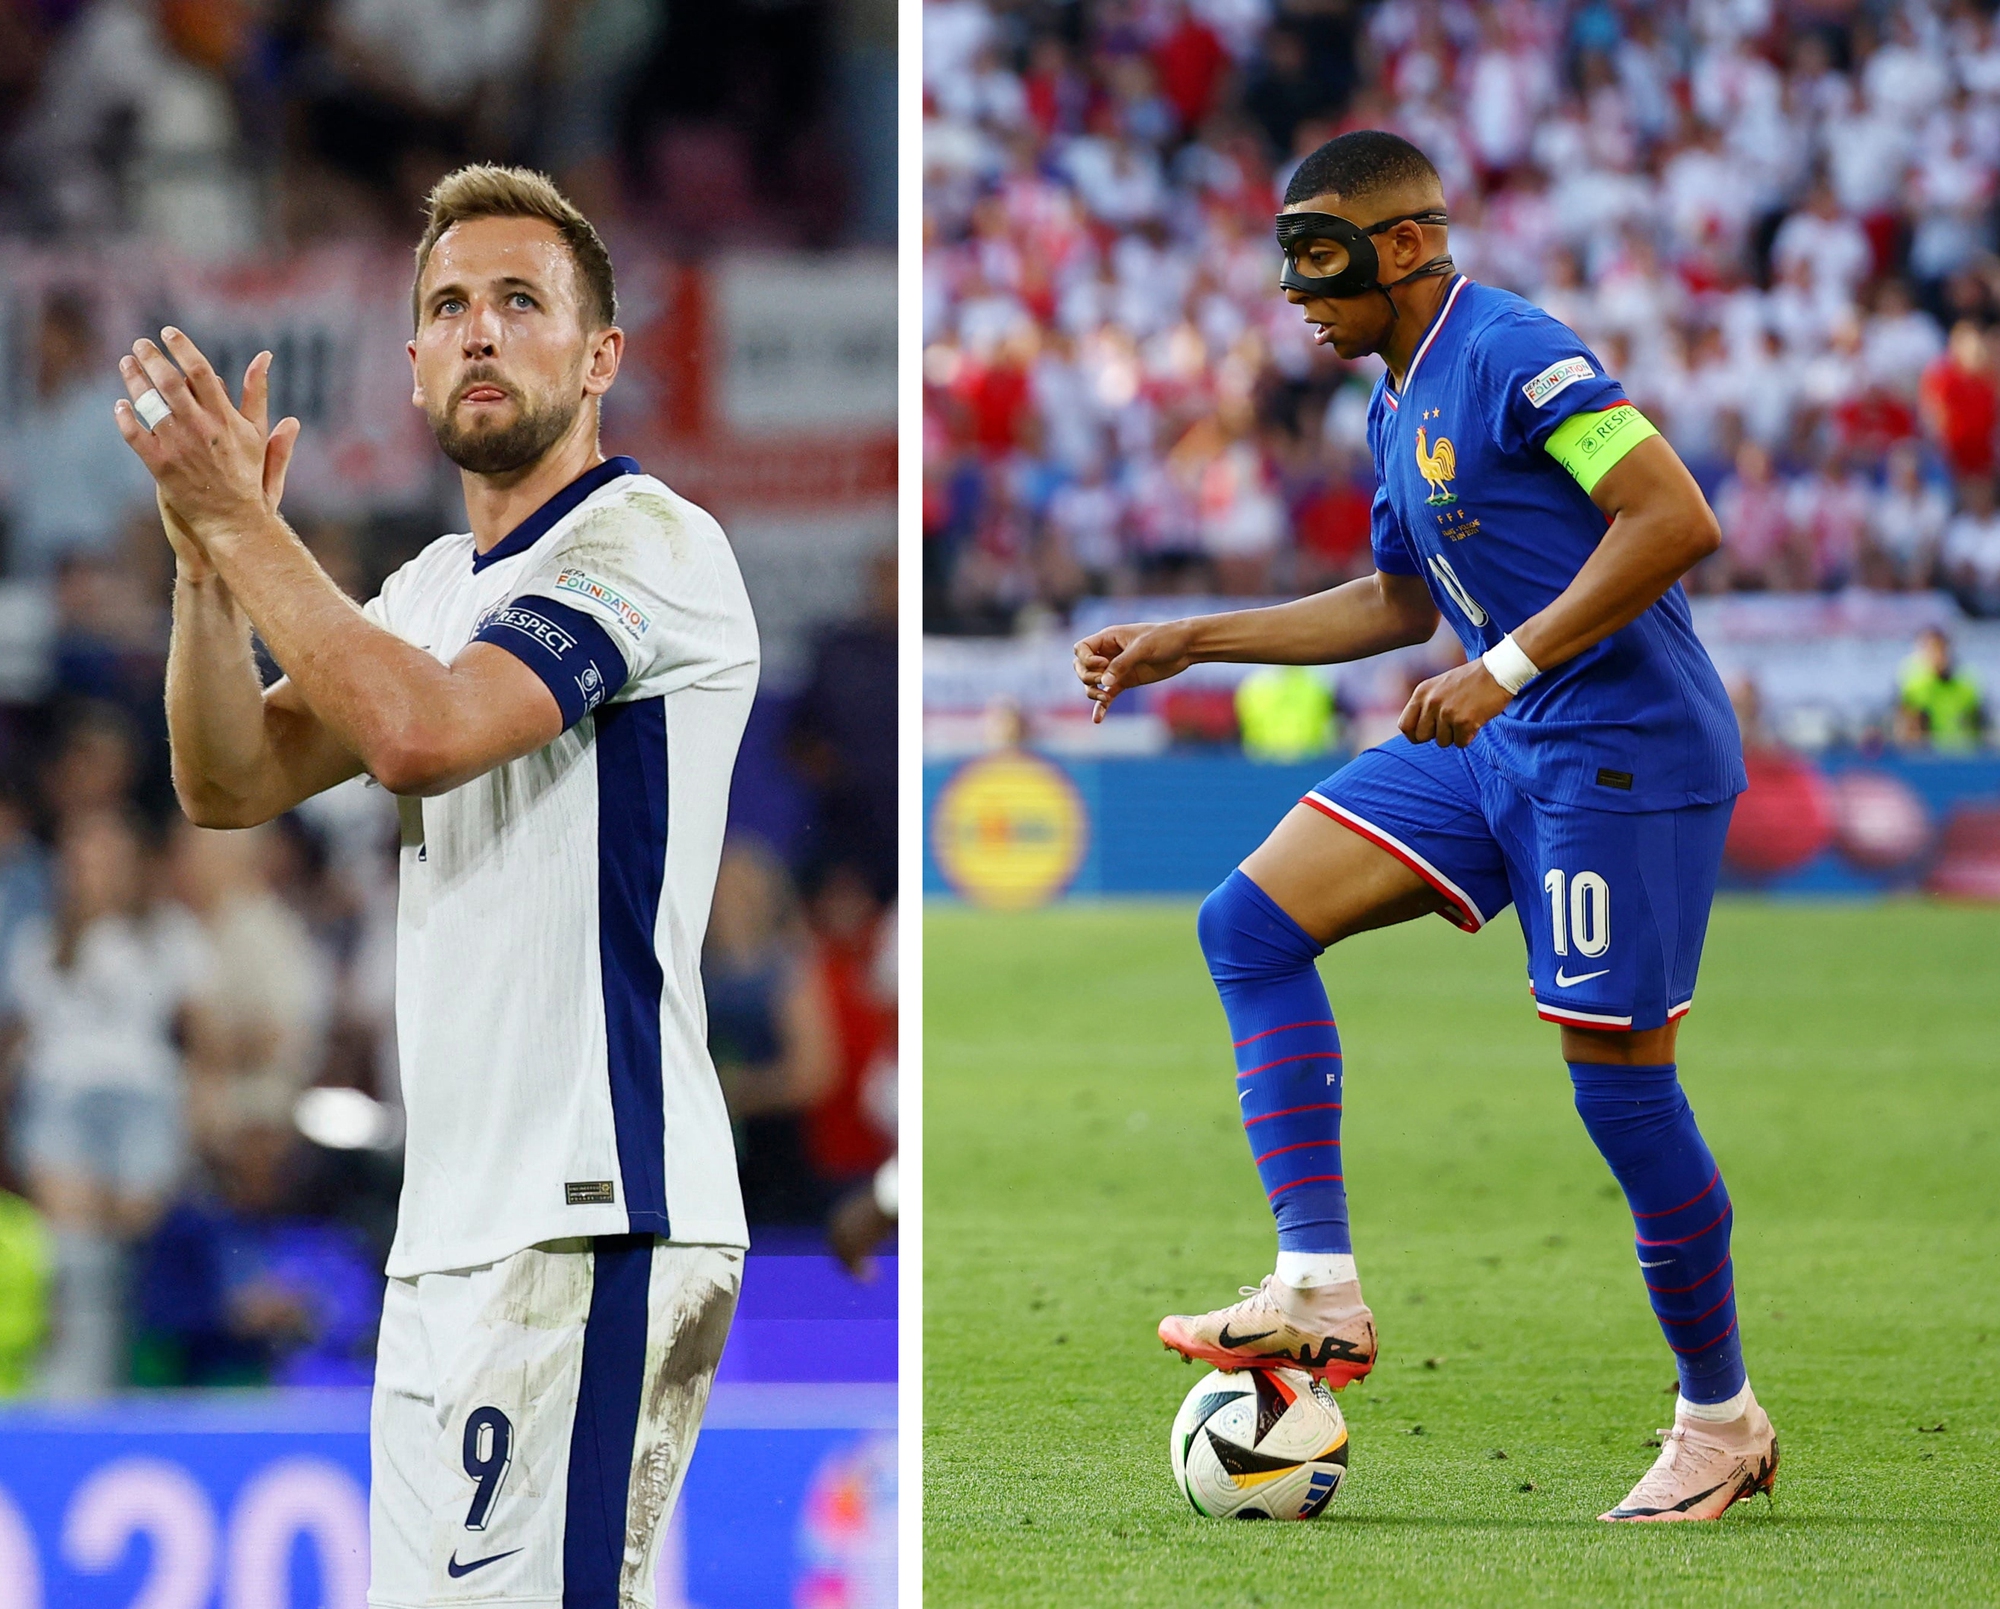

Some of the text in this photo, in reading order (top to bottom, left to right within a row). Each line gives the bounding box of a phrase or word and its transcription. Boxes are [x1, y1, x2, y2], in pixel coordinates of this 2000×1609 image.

[1525, 379, 1541, 392] UEFA
[1528, 362, 1589, 400] FOUNDATION
[562, 566, 586, 579] UEFA
[556, 575, 649, 634] FOUNDATION
[495, 610, 573, 654] RESPECT
[1544, 868, 1610, 958] 10
[462, 1405, 512, 1531] 9
